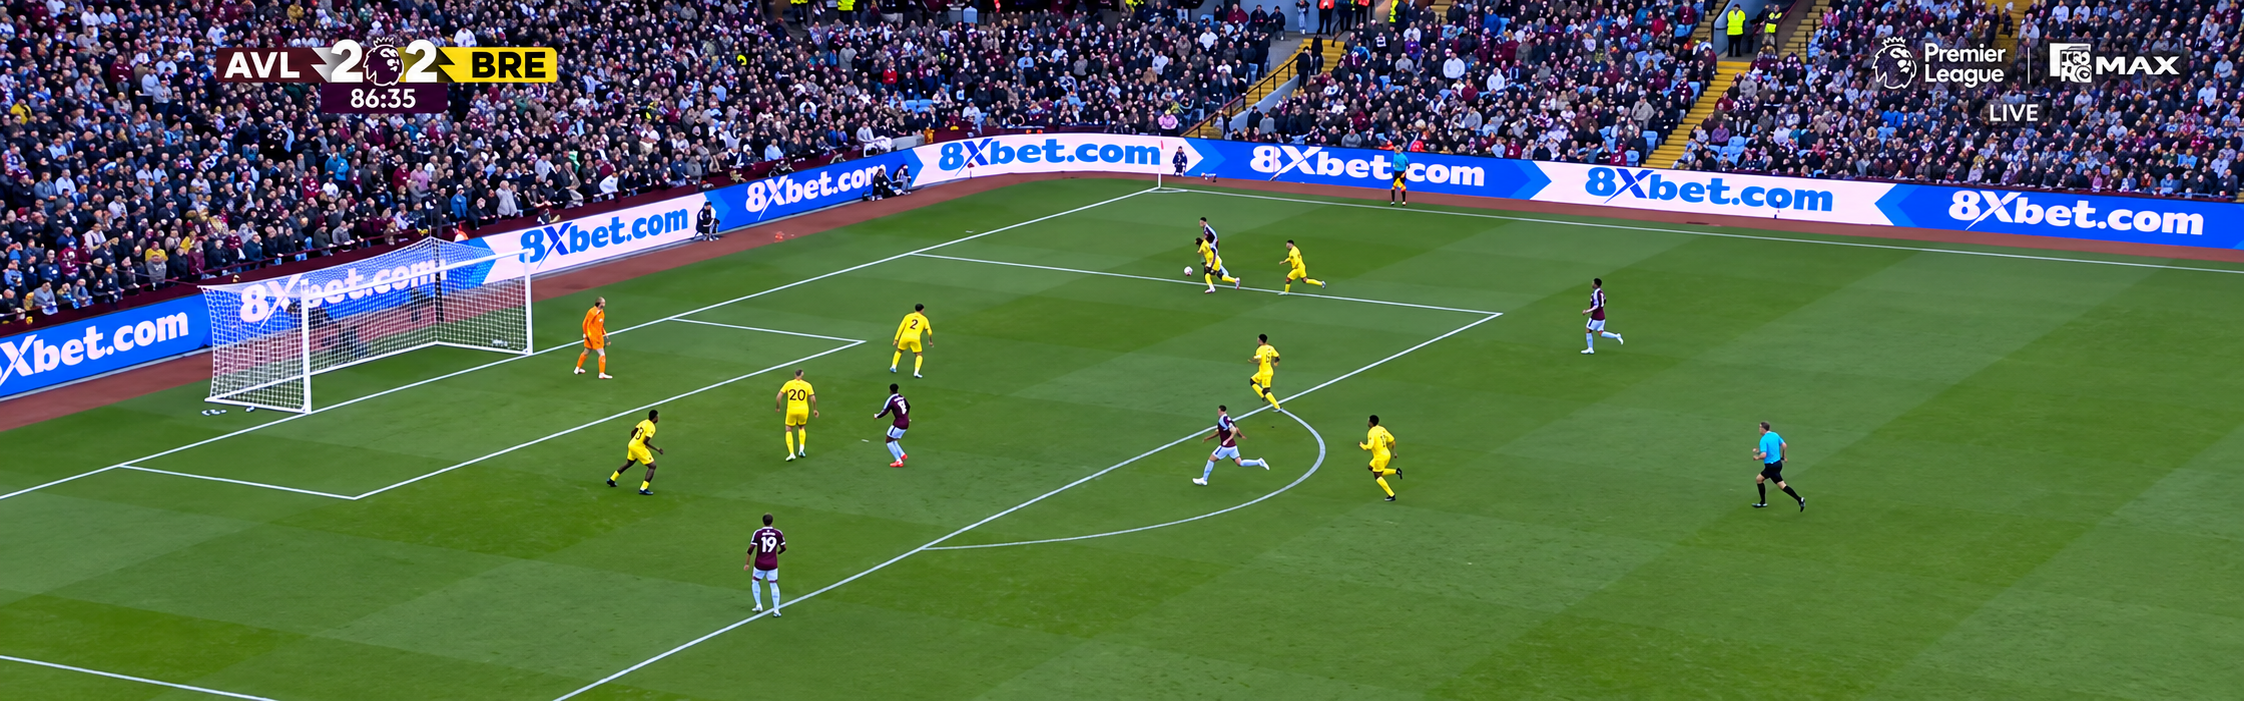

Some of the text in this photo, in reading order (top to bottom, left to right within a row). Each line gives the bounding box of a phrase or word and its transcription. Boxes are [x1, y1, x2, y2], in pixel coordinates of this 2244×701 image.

[938, 138, 1160, 177] 8Xbet.com
[1250, 145, 1485, 187] 8Xbetcom
[1585, 167, 1833, 212] 8Xbet.com
[1948, 190, 2204, 235] 8Xbet.com
[519, 208, 688, 270] 8Xbet.com
[910, 319, 918, 330] 2
[0, 312, 189, 386] Xbet.com
[788, 389, 806, 401] 20
[761, 536, 777, 553] 19
